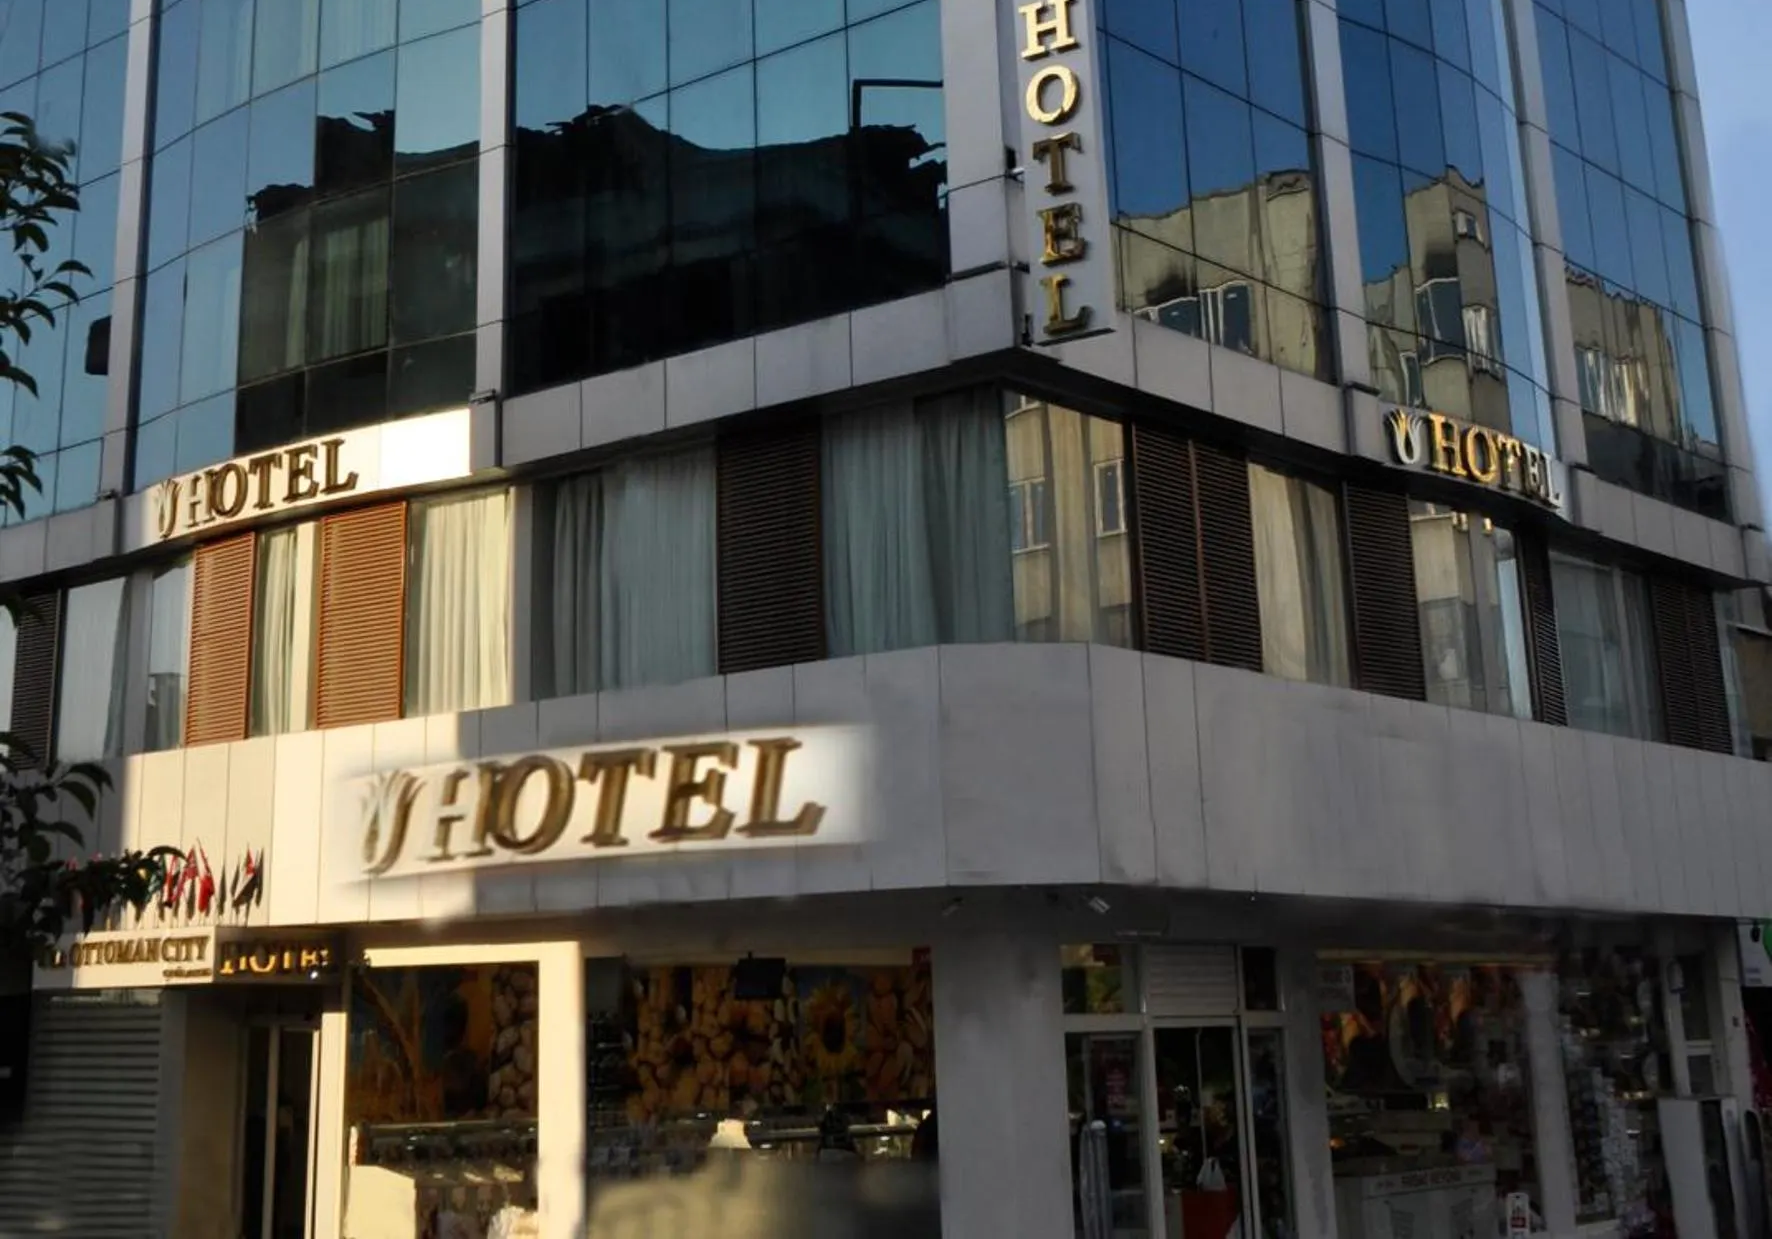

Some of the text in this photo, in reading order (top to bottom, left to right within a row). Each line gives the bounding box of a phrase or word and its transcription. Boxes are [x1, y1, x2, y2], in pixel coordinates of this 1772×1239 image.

[187, 437, 359, 529] HOTEL
[1428, 413, 1562, 508] HOTEL
[421, 735, 828, 863] HOTEL
[69, 937, 160, 968] OTTOMAN
[161, 935, 210, 963] CITY
